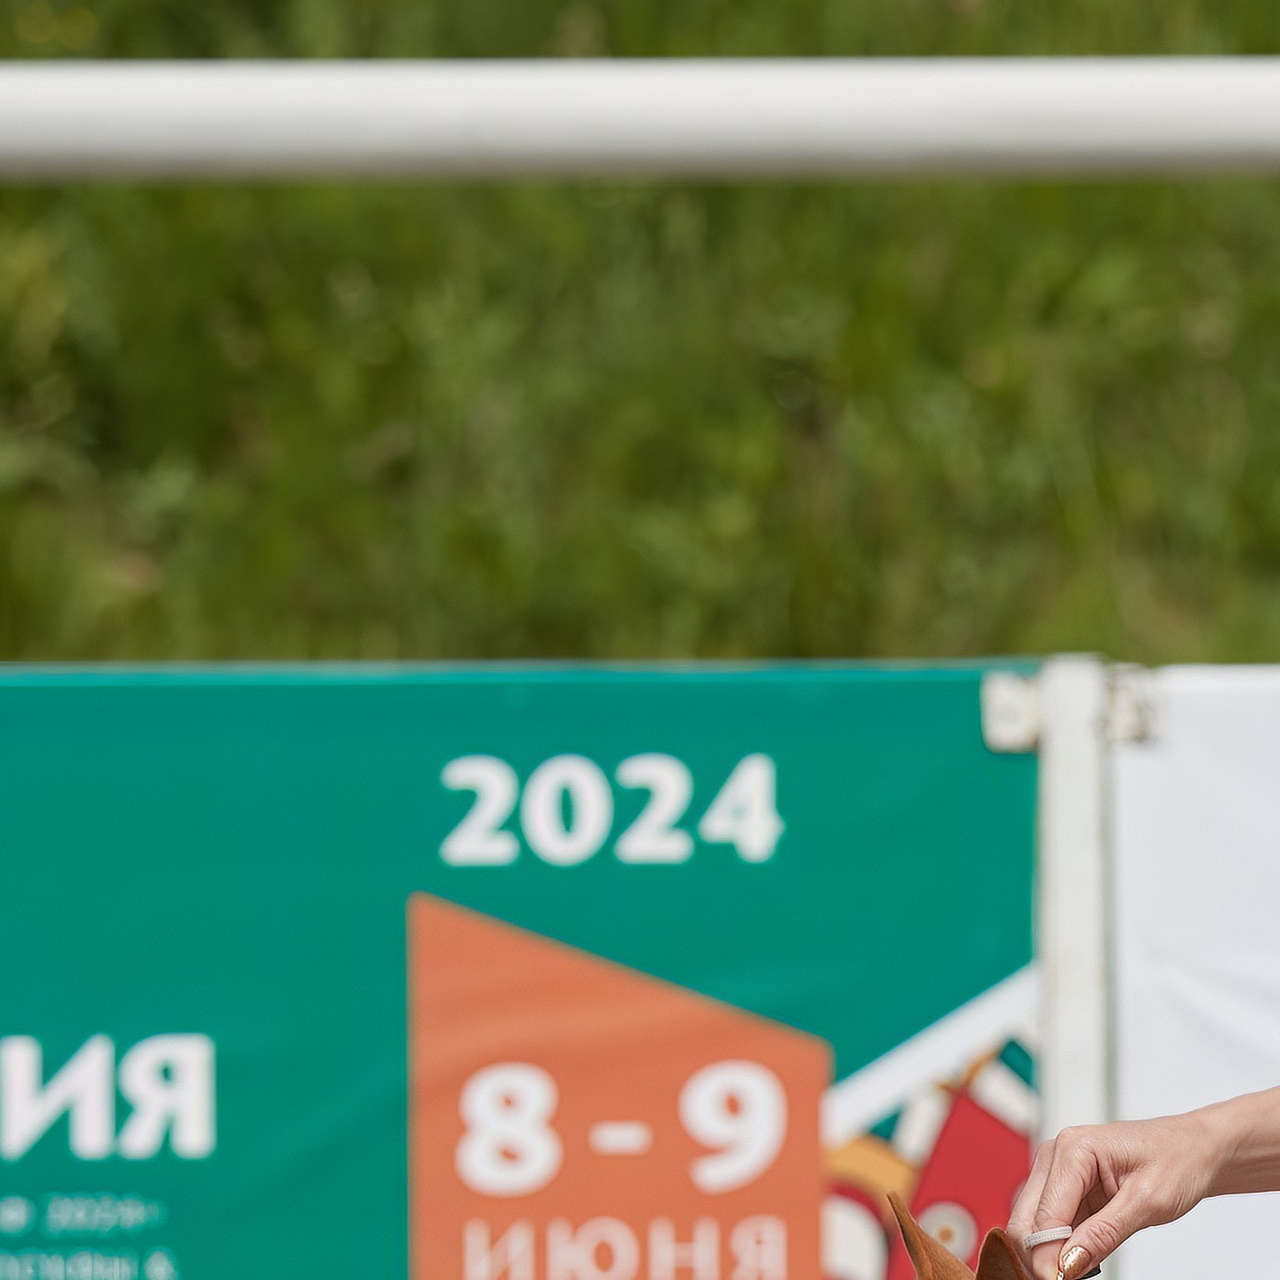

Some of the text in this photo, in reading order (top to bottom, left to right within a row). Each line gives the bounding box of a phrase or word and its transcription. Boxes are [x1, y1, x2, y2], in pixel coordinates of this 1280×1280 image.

[439, 753, 786, 867] 2024
[0, 1033, 216, 1161] ИЯ
[455, 1061, 564, 1198] 8
[678, 1059, 789, 1195] 9
